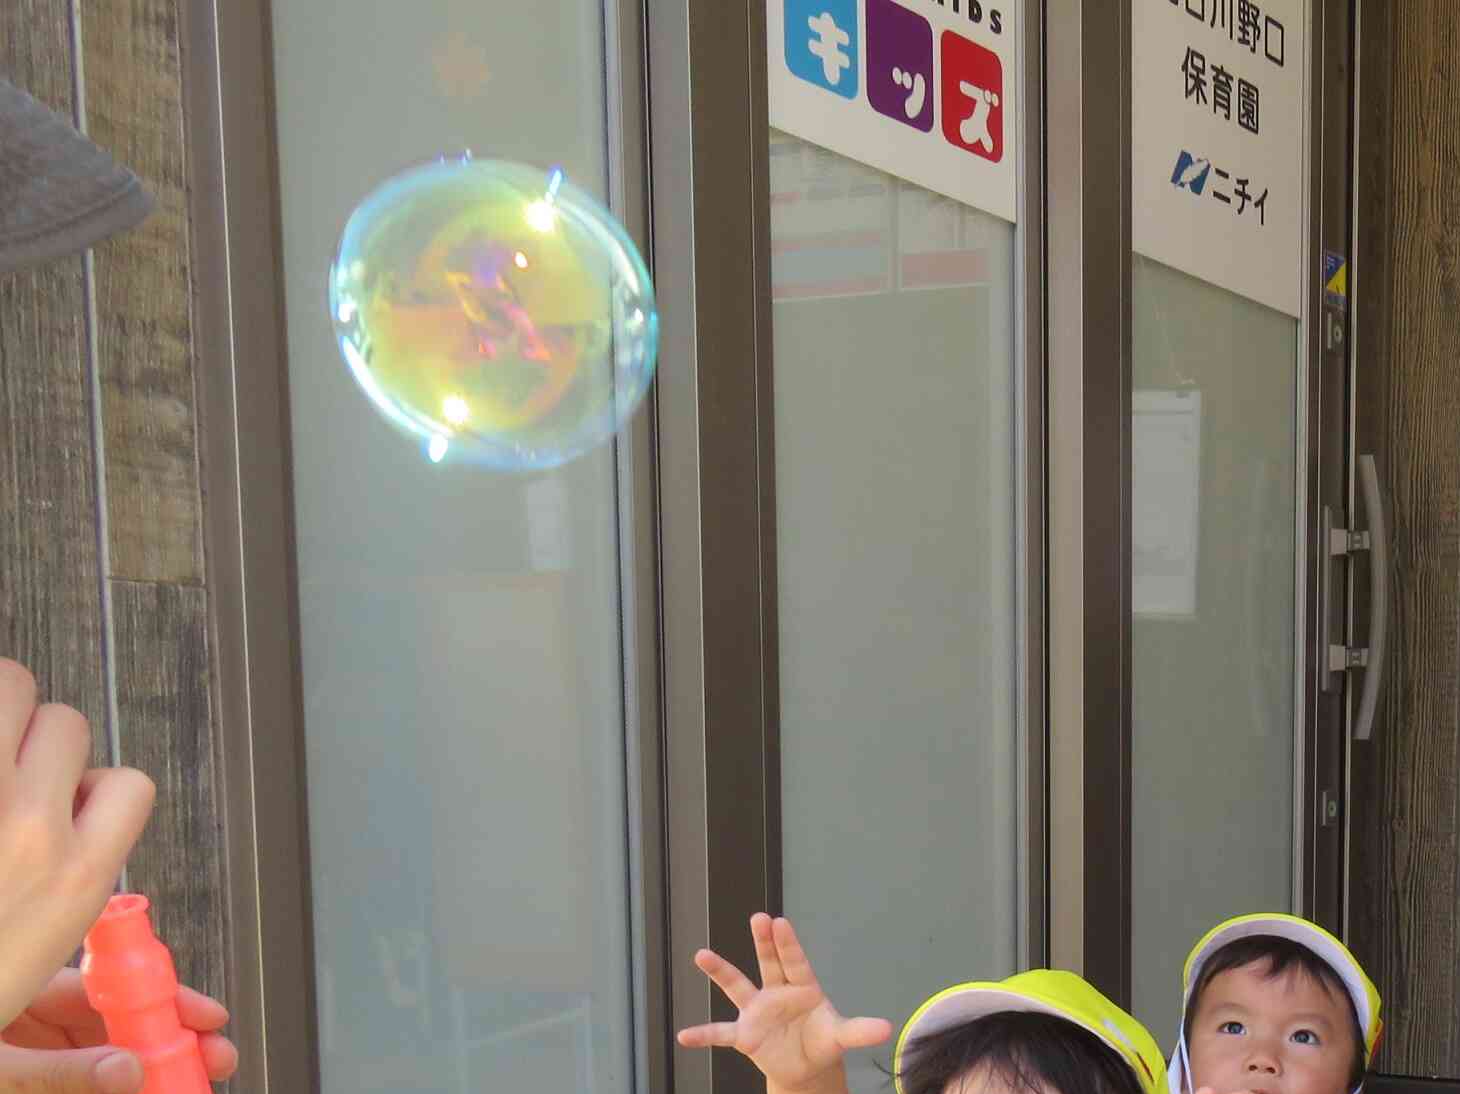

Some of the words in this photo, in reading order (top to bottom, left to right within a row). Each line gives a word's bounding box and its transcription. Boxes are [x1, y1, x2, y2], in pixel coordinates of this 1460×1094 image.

[1169, 0, 1284, 67] 川野口
[807, 12, 998, 153] キッズ
[1181, 46, 1259, 135] 保育園
[1213, 167, 1268, 226] ニチイ
